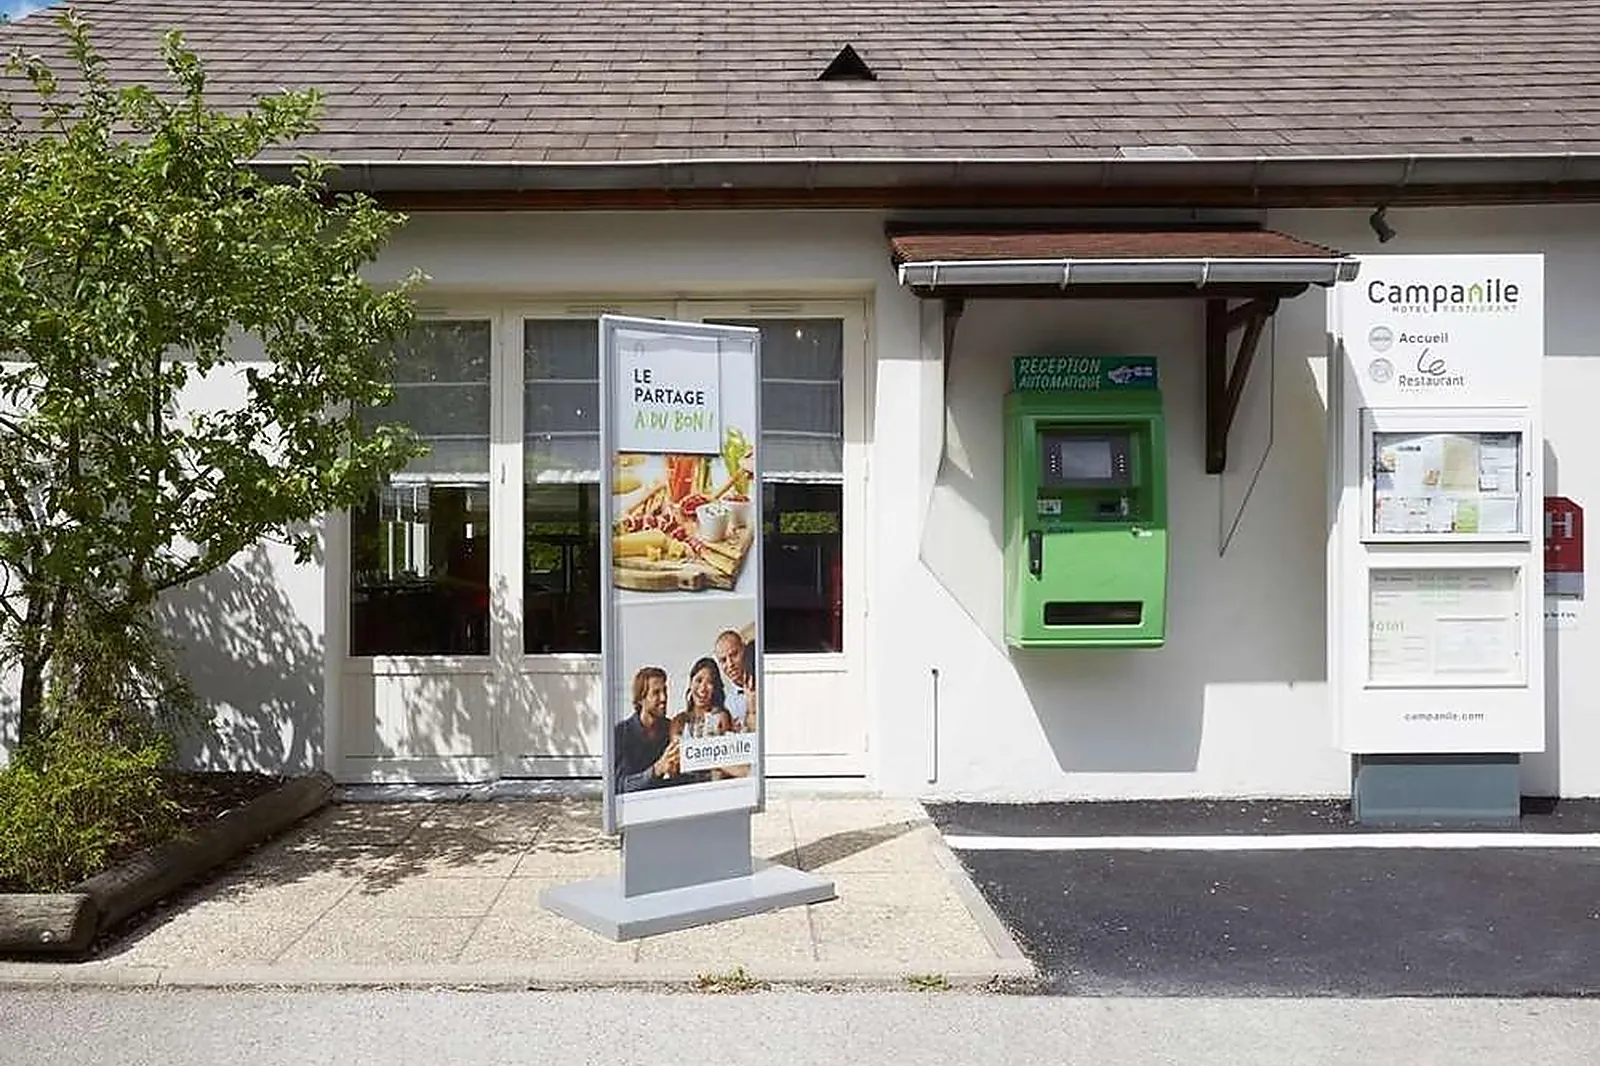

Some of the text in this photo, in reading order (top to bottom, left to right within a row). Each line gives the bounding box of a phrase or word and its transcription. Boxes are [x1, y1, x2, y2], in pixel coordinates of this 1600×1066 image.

[1368, 278, 1520, 312] Campanile
[1399, 332, 1449, 344] Accueil
[1019, 357, 1102, 375] RECEPTION
[1417, 348, 1447, 376] Le
[634, 368, 651, 384] LE
[1018, 374, 1102, 390] AUTOMATIQUE
[1398, 375, 1465, 387] Restaurant
[634, 387, 705, 405] PARTAGE
[1403, 712, 1485, 723] campanile.com
[685, 740, 752, 761] Campanile
